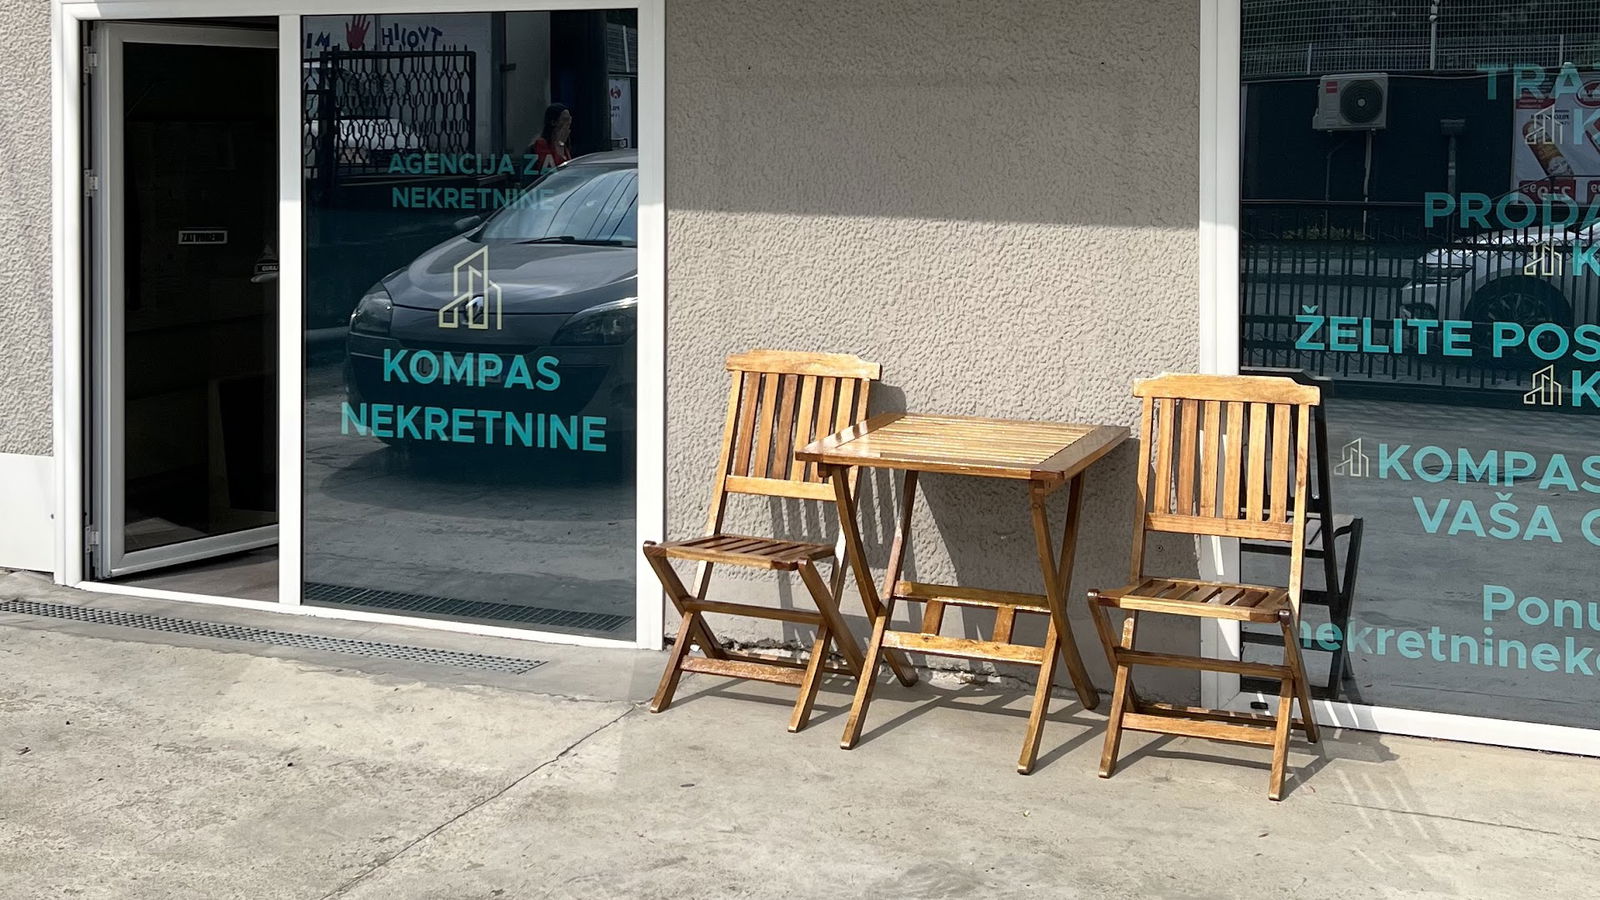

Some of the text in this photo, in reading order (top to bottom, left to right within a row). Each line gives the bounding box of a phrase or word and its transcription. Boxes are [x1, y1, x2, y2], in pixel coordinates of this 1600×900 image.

[1476, 62, 1600, 100] TRA
[388, 153, 559, 176] AGENCIJA ZA
[392, 187, 555, 211] NEKRETNINE
[1295, 305, 1600, 362] ŽELITE POS
[383, 348, 561, 391] KOMPAS
[340, 401, 608, 452] NEKRETNINE
[1378, 443, 1600, 494] KOMPAS
[1412, 492, 1563, 543] VAŠA
